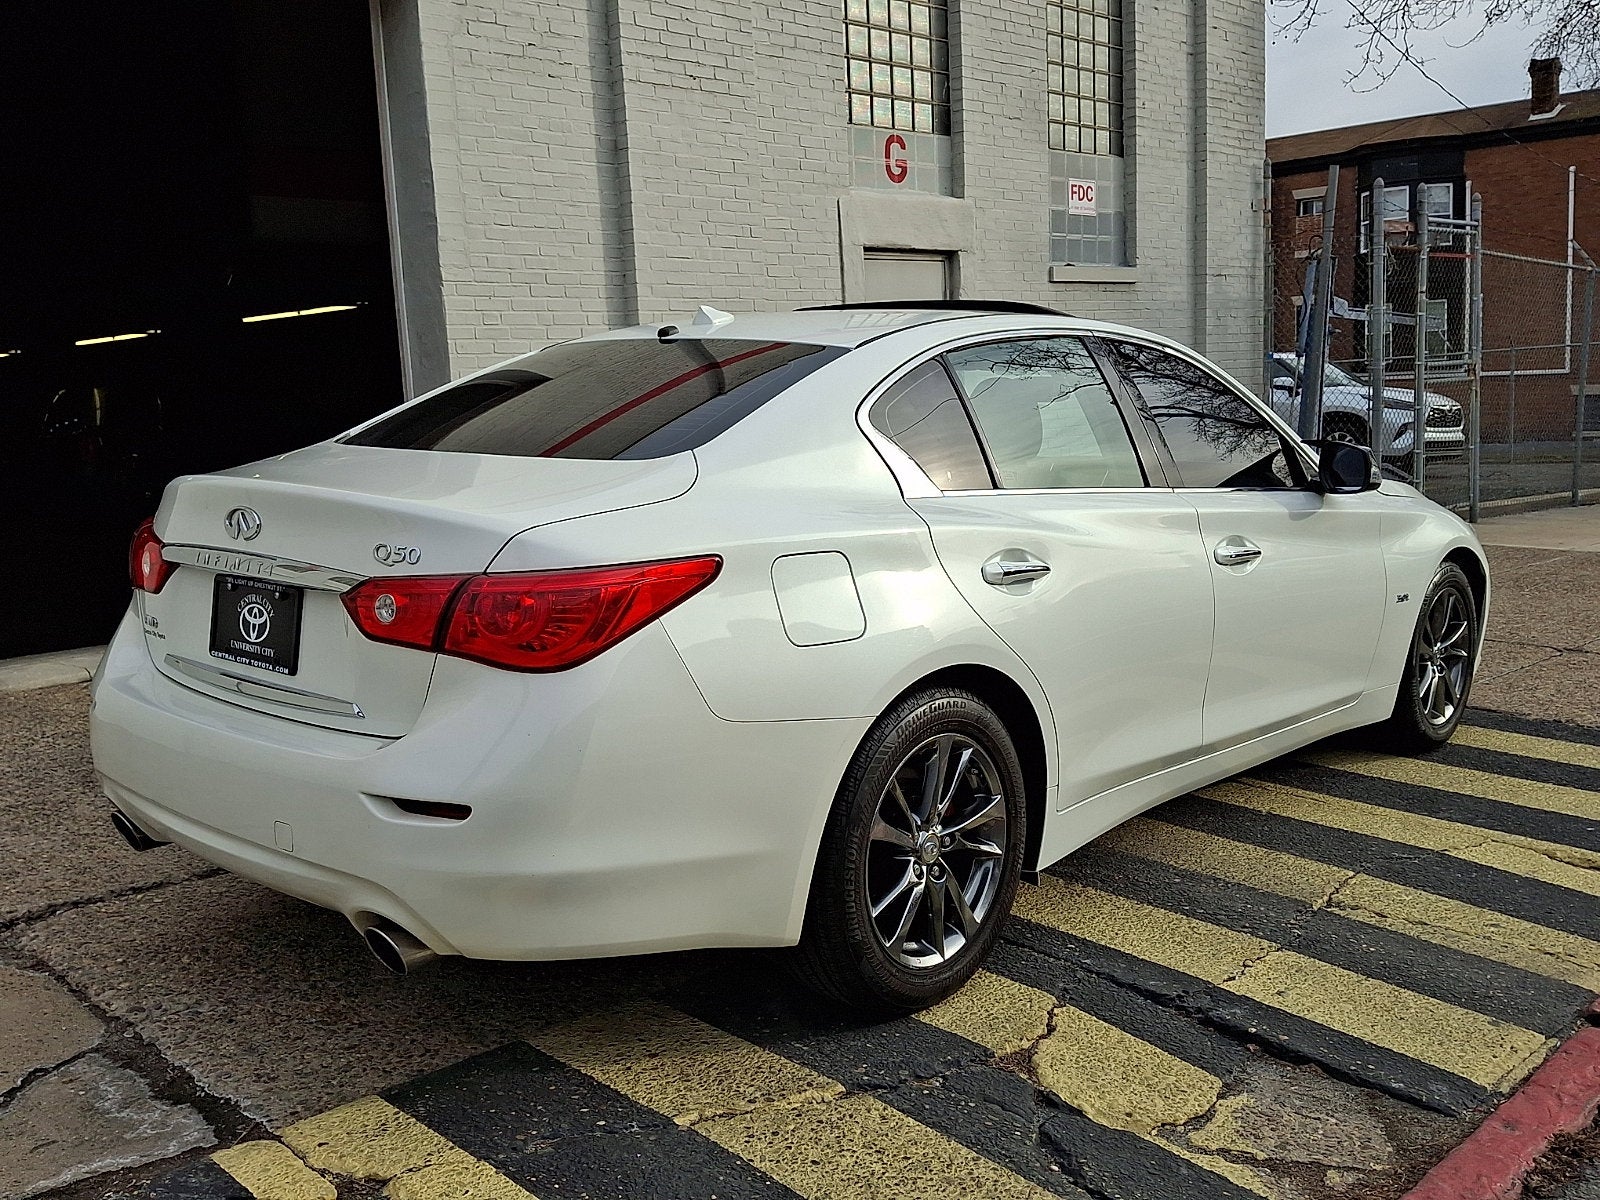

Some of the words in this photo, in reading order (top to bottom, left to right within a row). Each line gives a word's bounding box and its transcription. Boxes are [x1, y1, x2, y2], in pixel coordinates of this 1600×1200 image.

[885, 134, 908, 184] G
[1071, 184, 1094, 203] FDC
[197, 551, 274, 576] INFINITI
[373, 543, 422, 567] Q50
[234, 578, 247, 586] LIGHT
[254, 581, 276, 591] CHESTNUT
[237, 593, 262, 612] CENTRAL
[262, 596, 275, 618] CITY
[230, 639, 261, 655] UNIVERSITY
[261, 647, 275, 658] CITY
[211, 650, 236, 662] CENTRAL
[236, 656, 250, 665] CITY
[250, 659, 273, 671] TOYOTA
[273, 665, 289, 675] .COM
